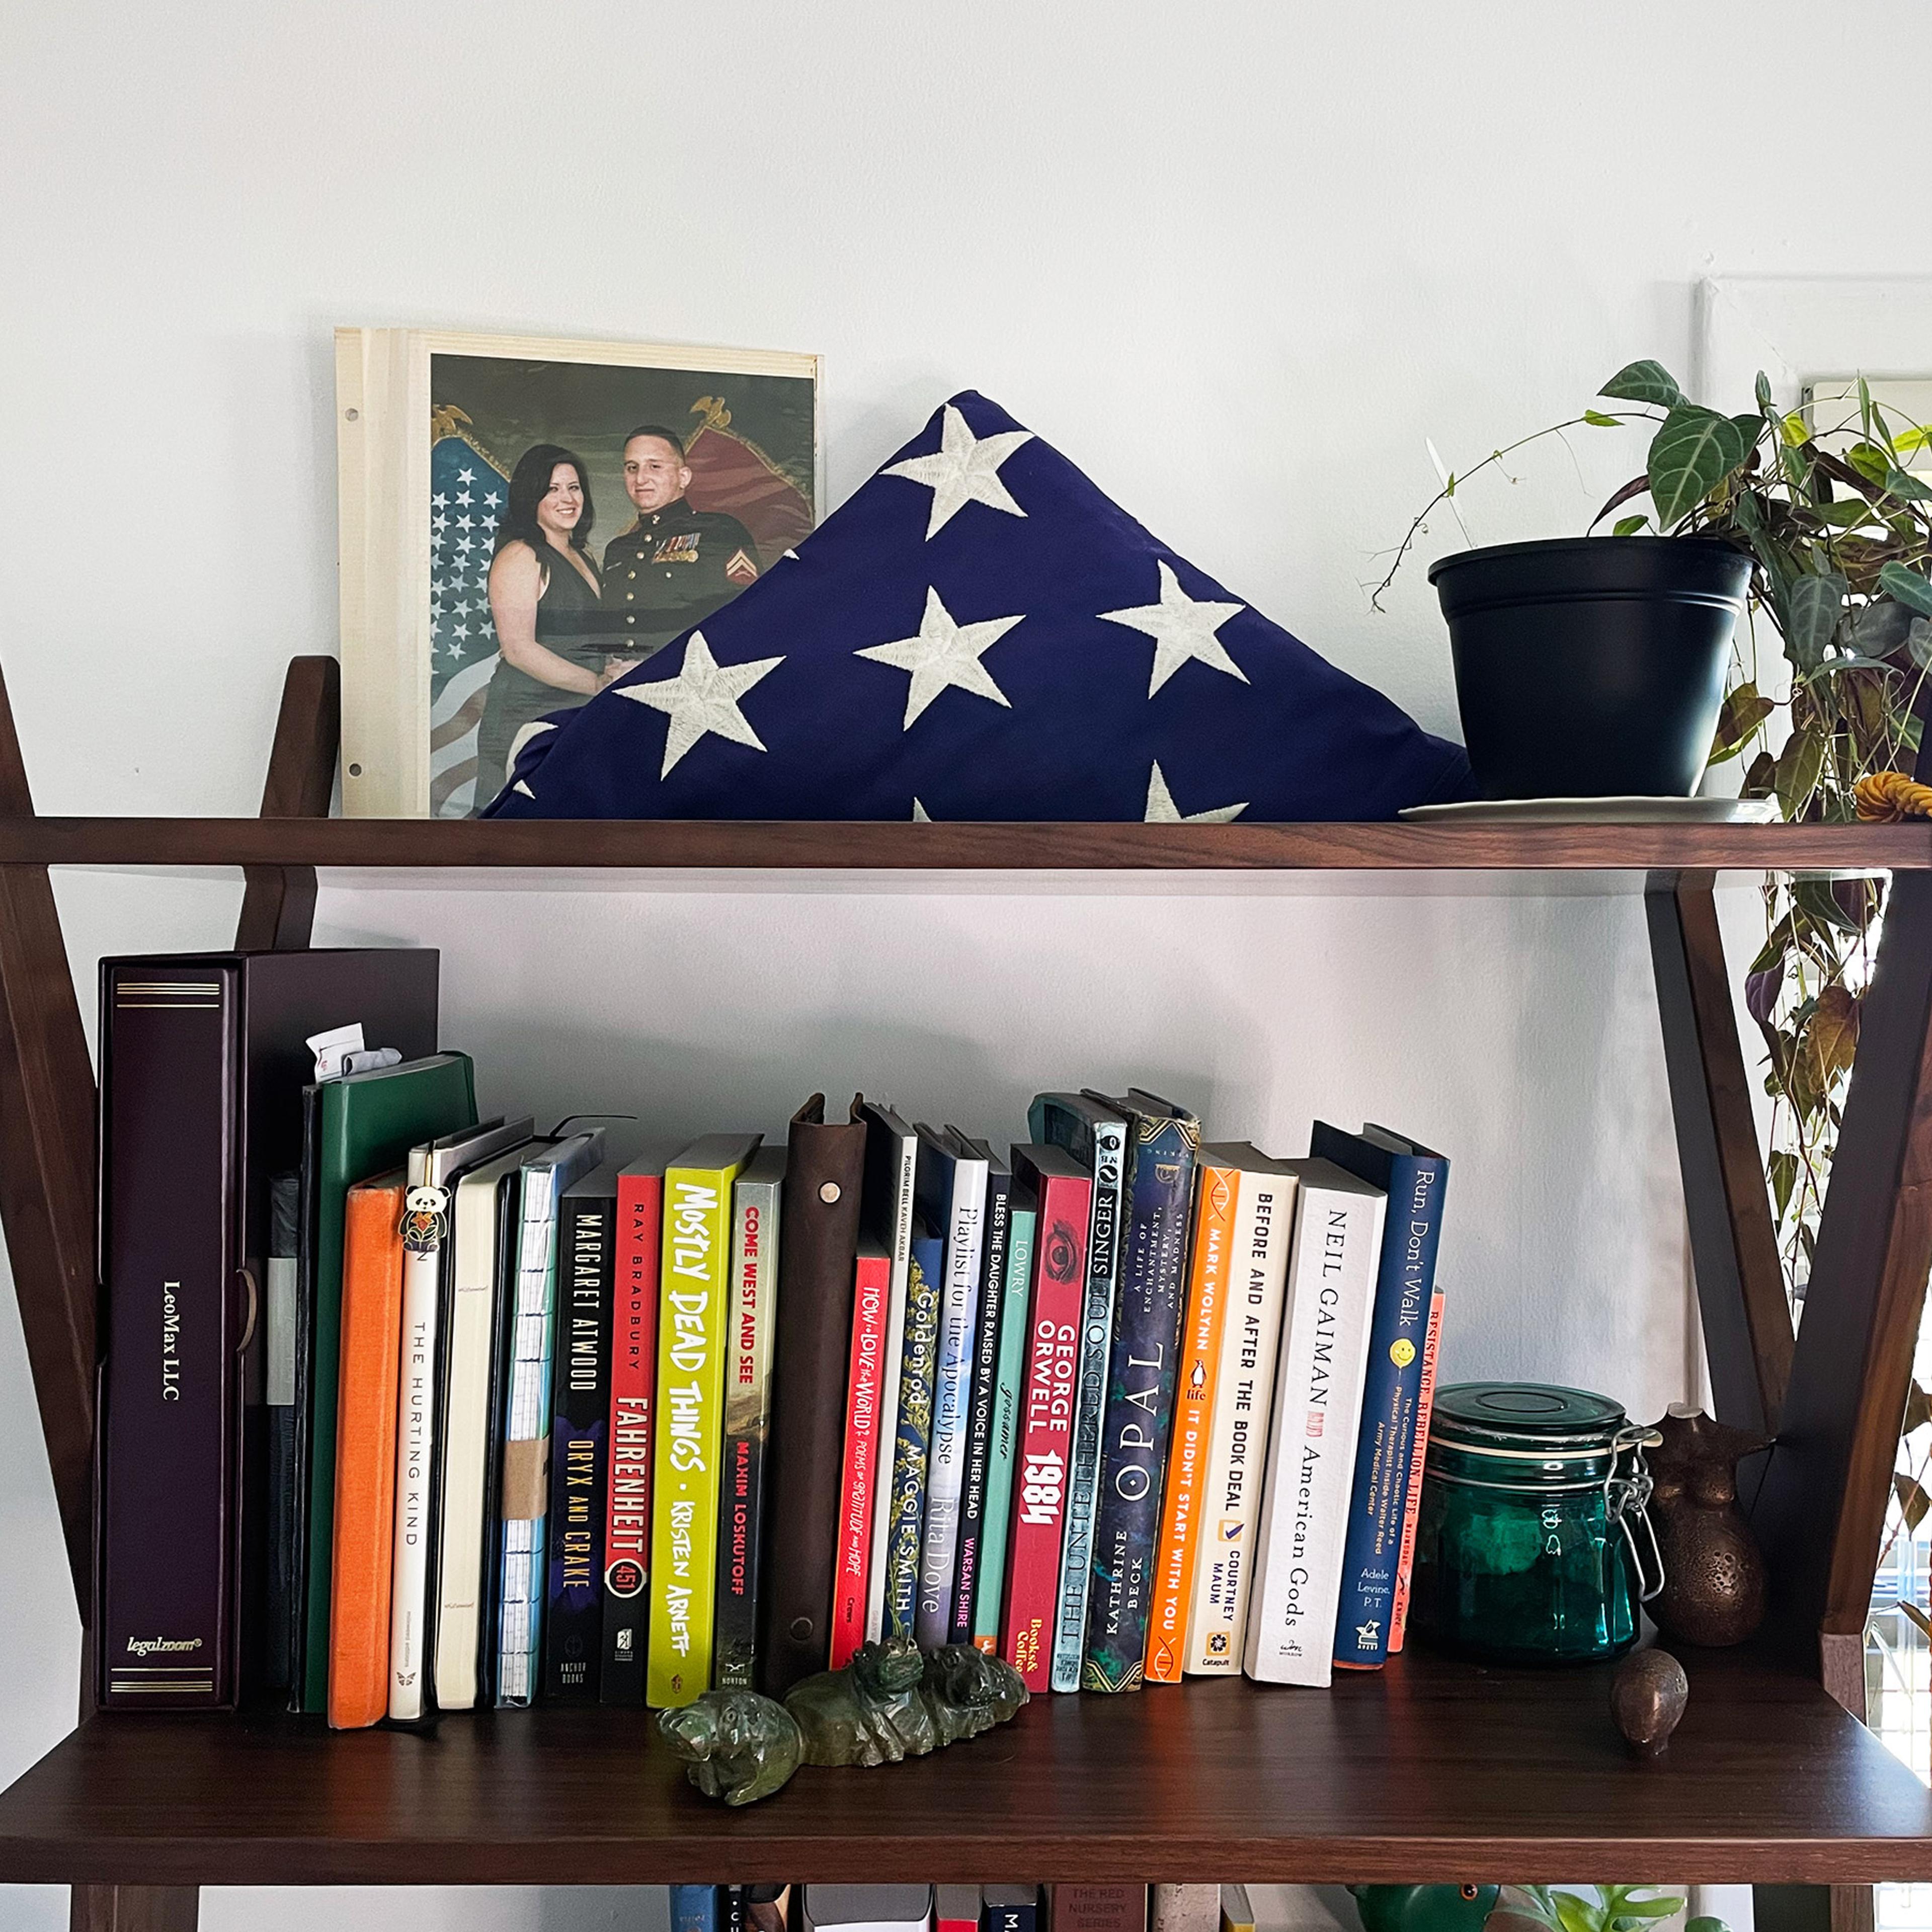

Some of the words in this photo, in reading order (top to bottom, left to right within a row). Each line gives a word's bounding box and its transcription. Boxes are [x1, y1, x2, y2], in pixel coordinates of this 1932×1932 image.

[903, 1156, 912, 1186] PILGRIM
[1411, 1170, 1435, 1214] Run,
[902, 1189, 910, 1204] BELL
[992, 1194, 1007, 1228] BLESS
[633, 1204, 645, 1241] RAY
[673, 1182, 717, 1280] MOSTLY
[744, 1206, 760, 1257] COME
[953, 1207, 979, 1278] Playlist
[990, 1230, 1004, 1252] THE
[1093, 1195, 1114, 1275] SINGER
[1139, 1224, 1147, 1240] OF
[1171, 1214, 1183, 1274] MADNESS
[1251, 1193, 1273, 1258] BEFORE
[1322, 1210, 1348, 1278] NEIL
[573, 1214, 603, 1309] MARGARET
[898, 1235, 906, 1262] AKBAR
[1135, 1246, 1144, 1276] LIFE
[1144, 1207, 1162, 1313] ENCHANTMENT,
[1157, 1229, 1173, 1293] MYSTERY,
[1205, 1228, 1222, 1277] MARK
[1405, 1220, 1429, 1271] Don't
[742, 1263, 758, 1309] WEST
[985, 1254, 1002, 1318] DAUGHTER
[1010, 1240, 1029, 1297] LOWRY
[1248, 1268, 1267, 1305] AND
[164, 1281, 180, 1354] LeoMax
[628, 1257, 642, 1370] BRADBURY
[862, 1287, 880, 1324] HOW
[951, 1283, 974, 1311] for
[1196, 1282, 1216, 1349] WOLYNN
[1399, 1278, 1422, 1326] Walk
[413, 1322, 426, 1364] THE
[669, 1291, 708, 1370] DEAD
[741, 1312, 756, 1350] AND
[948, 1317, 970, 1347] the
[981, 1321, 997, 1364] RAISED
[1086, 1290, 1106, 1357] SOUL
[1241, 1316, 1261, 1369] AFTER
[570, 1318, 598, 1390] ATWOOD
[859, 1333, 878, 1370] LOVE
[909, 1292, 935, 1405] Goldenrod
[1309, 1287, 1339, 1406] GAIMAN
[163, 1359, 180, 1401] LLC
[739, 1355, 754, 1383] SEE
[978, 1385, 992, 1396] A
[979, 1367, 994, 1383] BY
[1029, 1320, 1056, 1433] ORWELL
[1050, 1324, 1076, 1431] GEORGE
[934, 1352, 965, 1464] Apocalypse
[1187, 1389, 1207, 1401] life
[1187, 1409, 1199, 1423] IT
[1236, 1380, 1255, 1411] THE
[1390, 1386, 1402, 1423] Physical
[1404, 1397, 1412, 1414] The
[408, 1377, 424, 1479] HURTING
[670, 1381, 706, 1472] THINGS
[976, 1399, 991, 1439] VOICE
[998, 1383, 1015, 1461] gossamer
[1116, 1343, 1164, 1501] OPAL
[1375, 1422, 1386, 1445] Army
[1398, 1416, 1410, 1450] Curious
[567, 1439, 594, 1486] ORYX
[854, 1440, 867, 1470] POEMS
[974, 1442, 988, 1456] IN
[1181, 1431, 1198, 1489] DIDN'T
[1230, 1420, 1250, 1464] BOOK
[1384, 1426, 1398, 1467] Therapist
[1397, 1453, 1406, 1469] and
[612, 1397, 649, 1554] FAHRENHEIT
[735, 1441, 750, 1495] MAXIM
[971, 1459, 986, 1483] HER
[1019, 1450, 1066, 1524] 1984
[1067, 1370, 1101, 1572] UNTETHERED
[1370, 1448, 1382, 1483] Medical
[568, 1496, 588, 1522] AND
[901, 1445, 924, 1535] MAGGIE
[967, 1485, 985, 1519] HEAD
[1225, 1470, 1244, 1511] DEAL
[1292, 1444, 1322, 1559] American
[1367, 1485, 1379, 1515] Center
[1393, 1472, 1404, 1506] Chaotic
[1406, 1484, 1419, 1514] LIFE
[406, 1492, 419, 1546] KIND
[927, 1497, 956, 1545] Rita
[1174, 1494, 1190, 1545] START
[1378, 1499, 1390, 1528] Walter
[1389, 1527, 1398, 1538] of
[1390, 1508, 1400, 1525] Life
[563, 1532, 591, 1588] CRAKE
[671, 1501, 695, 1577] KRISTEN
[731, 1503, 747, 1594] LOSKUTOFF
[1375, 1532, 1385, 1555] Reed
[616, 1565, 636, 1589] 451
[846, 1547, 862, 1576] HOPE
[896, 1546, 914, 1611] SMITH
[921, 1549, 950, 1614] Dove
[959, 1537, 976, 1591] WARSAN
[1107, 1531, 1126, 1635] KATHRINE
[1127, 1558, 1143, 1609] BECK
[1168, 1551, 1182, 1591] WITH
[1209, 1563, 1225, 1604] MAUM
[1360, 1568, 1390, 1580] Adele
[1223, 1550, 1241, 1622] COURTNEY
[1284, 1567, 1309, 1628] Gods
[667, 1584, 692, 1656] ARNETT
[846, 1597, 855, 1623] Crews
[871, 1610, 879, 1640] GRAYW
[957, 1594, 972, 1628] SHIRE
[1061, 1584, 1081, 1644] THE
[1162, 1594, 1178, 1631] YOU
[1202, 1658, 1230, 1666] Catapult
